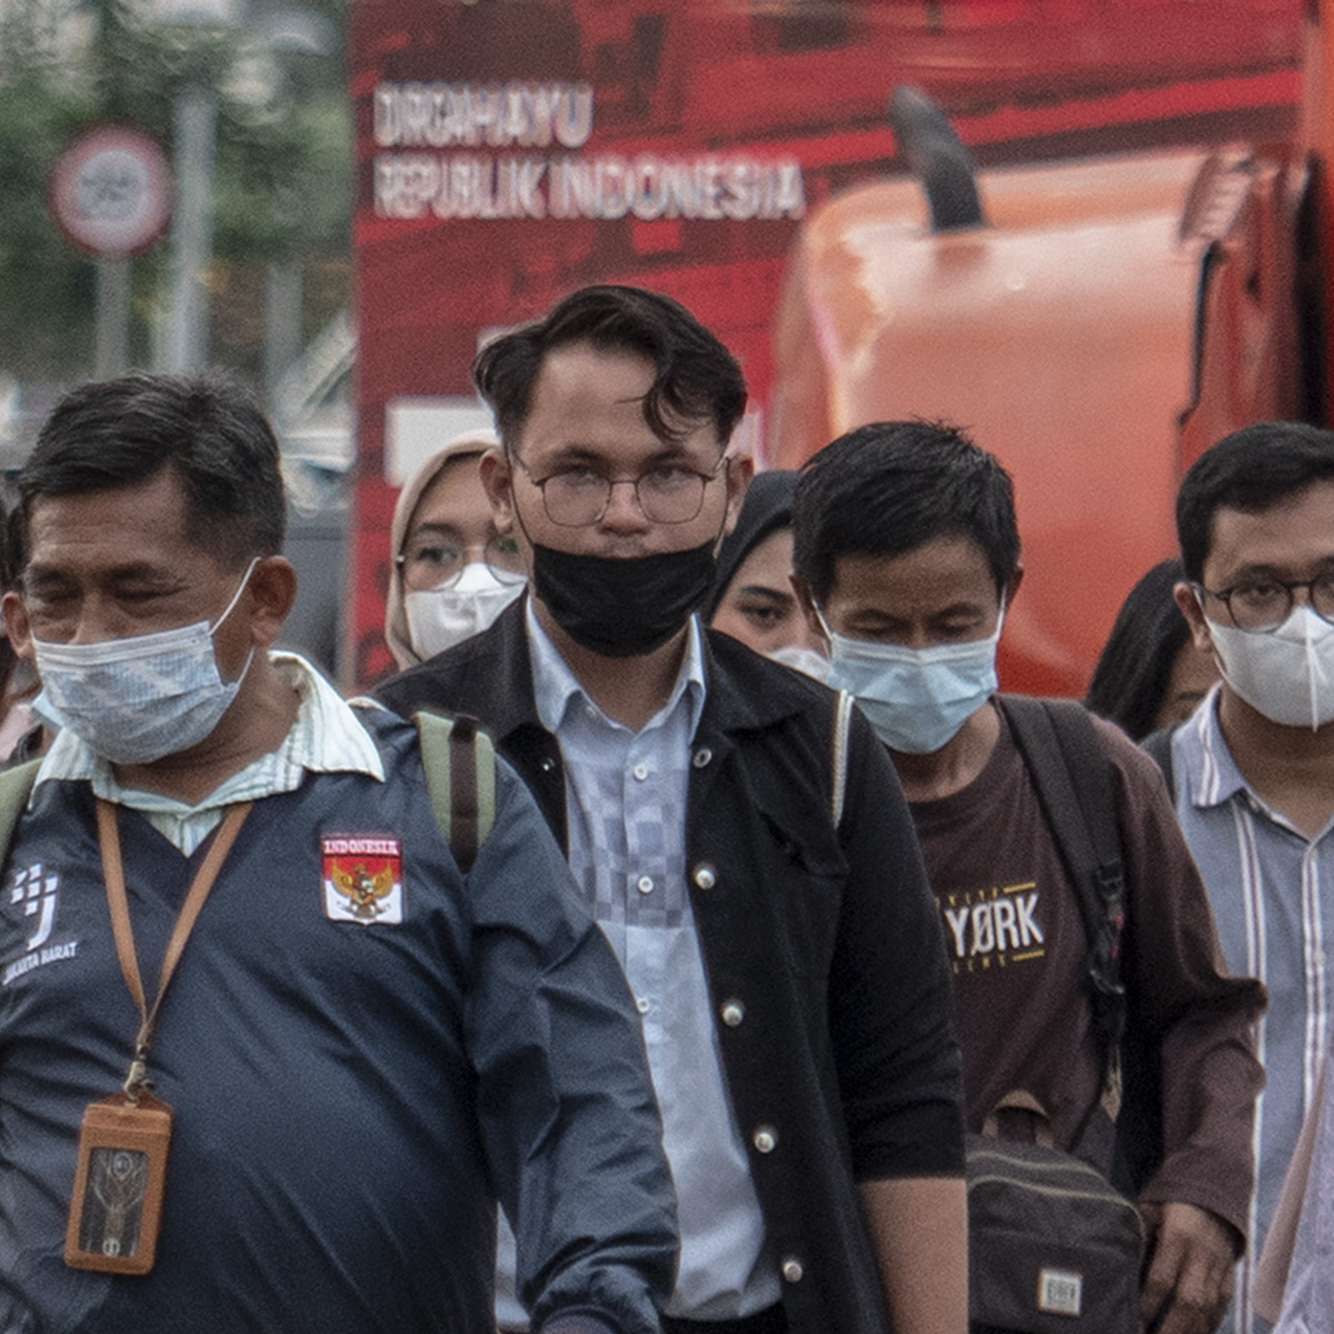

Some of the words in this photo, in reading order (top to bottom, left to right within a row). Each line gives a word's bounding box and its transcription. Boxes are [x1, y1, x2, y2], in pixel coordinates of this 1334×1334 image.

[373, 155, 550, 219] REPUBLIK
[552, 155, 805, 220] INDONESIA
[324, 840, 399, 855] INDONESIA
[41, 941, 78, 965] BARAT
